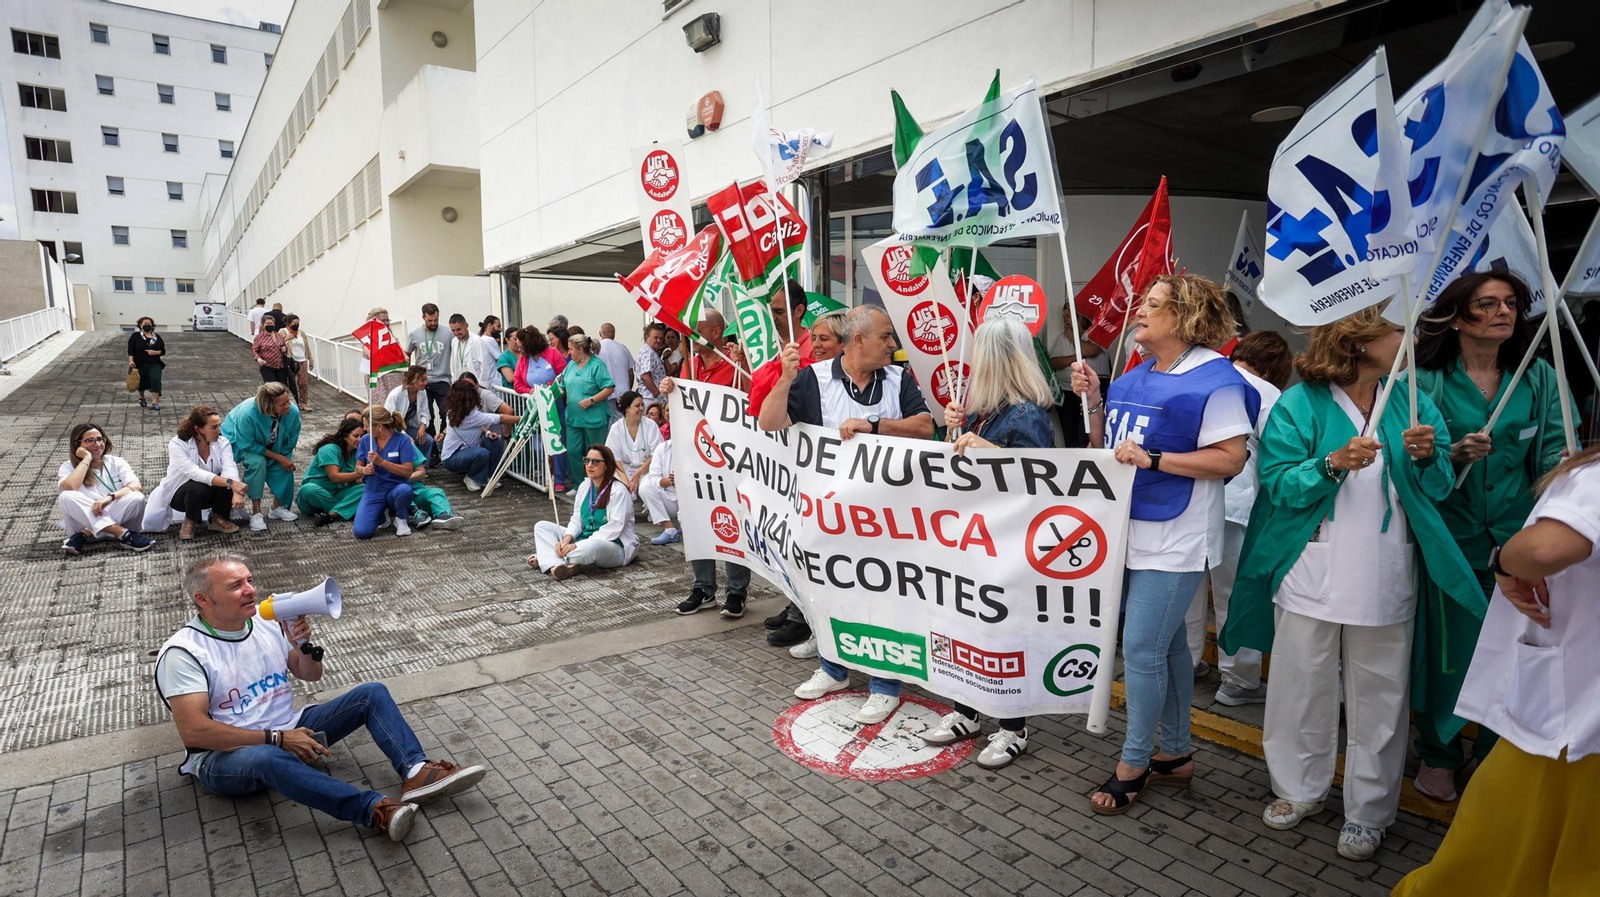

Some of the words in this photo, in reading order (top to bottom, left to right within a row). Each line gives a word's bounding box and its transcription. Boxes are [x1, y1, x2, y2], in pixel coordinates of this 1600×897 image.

[647, 154, 669, 171] UGT
[655, 213, 677, 231] UGT
[993, 285, 1034, 306] UGT
[677, 384, 711, 416] EN
[795, 430, 841, 477] DE
[849, 442, 1117, 501] NUESTRA
[716, 512, 733, 525] UGT
[800, 491, 997, 557] PÚBLICA
[792, 539, 1009, 624] RECORTES
[838, 632, 923, 670] SATSE
[955, 646, 1019, 674] CCOO
[932, 657, 964, 674] federación
[965, 669, 974, 677] de
[975, 674, 1004, 685] sanidad
[938, 668, 964, 682] sectores
[965, 678, 1022, 695] sociosanitarios
